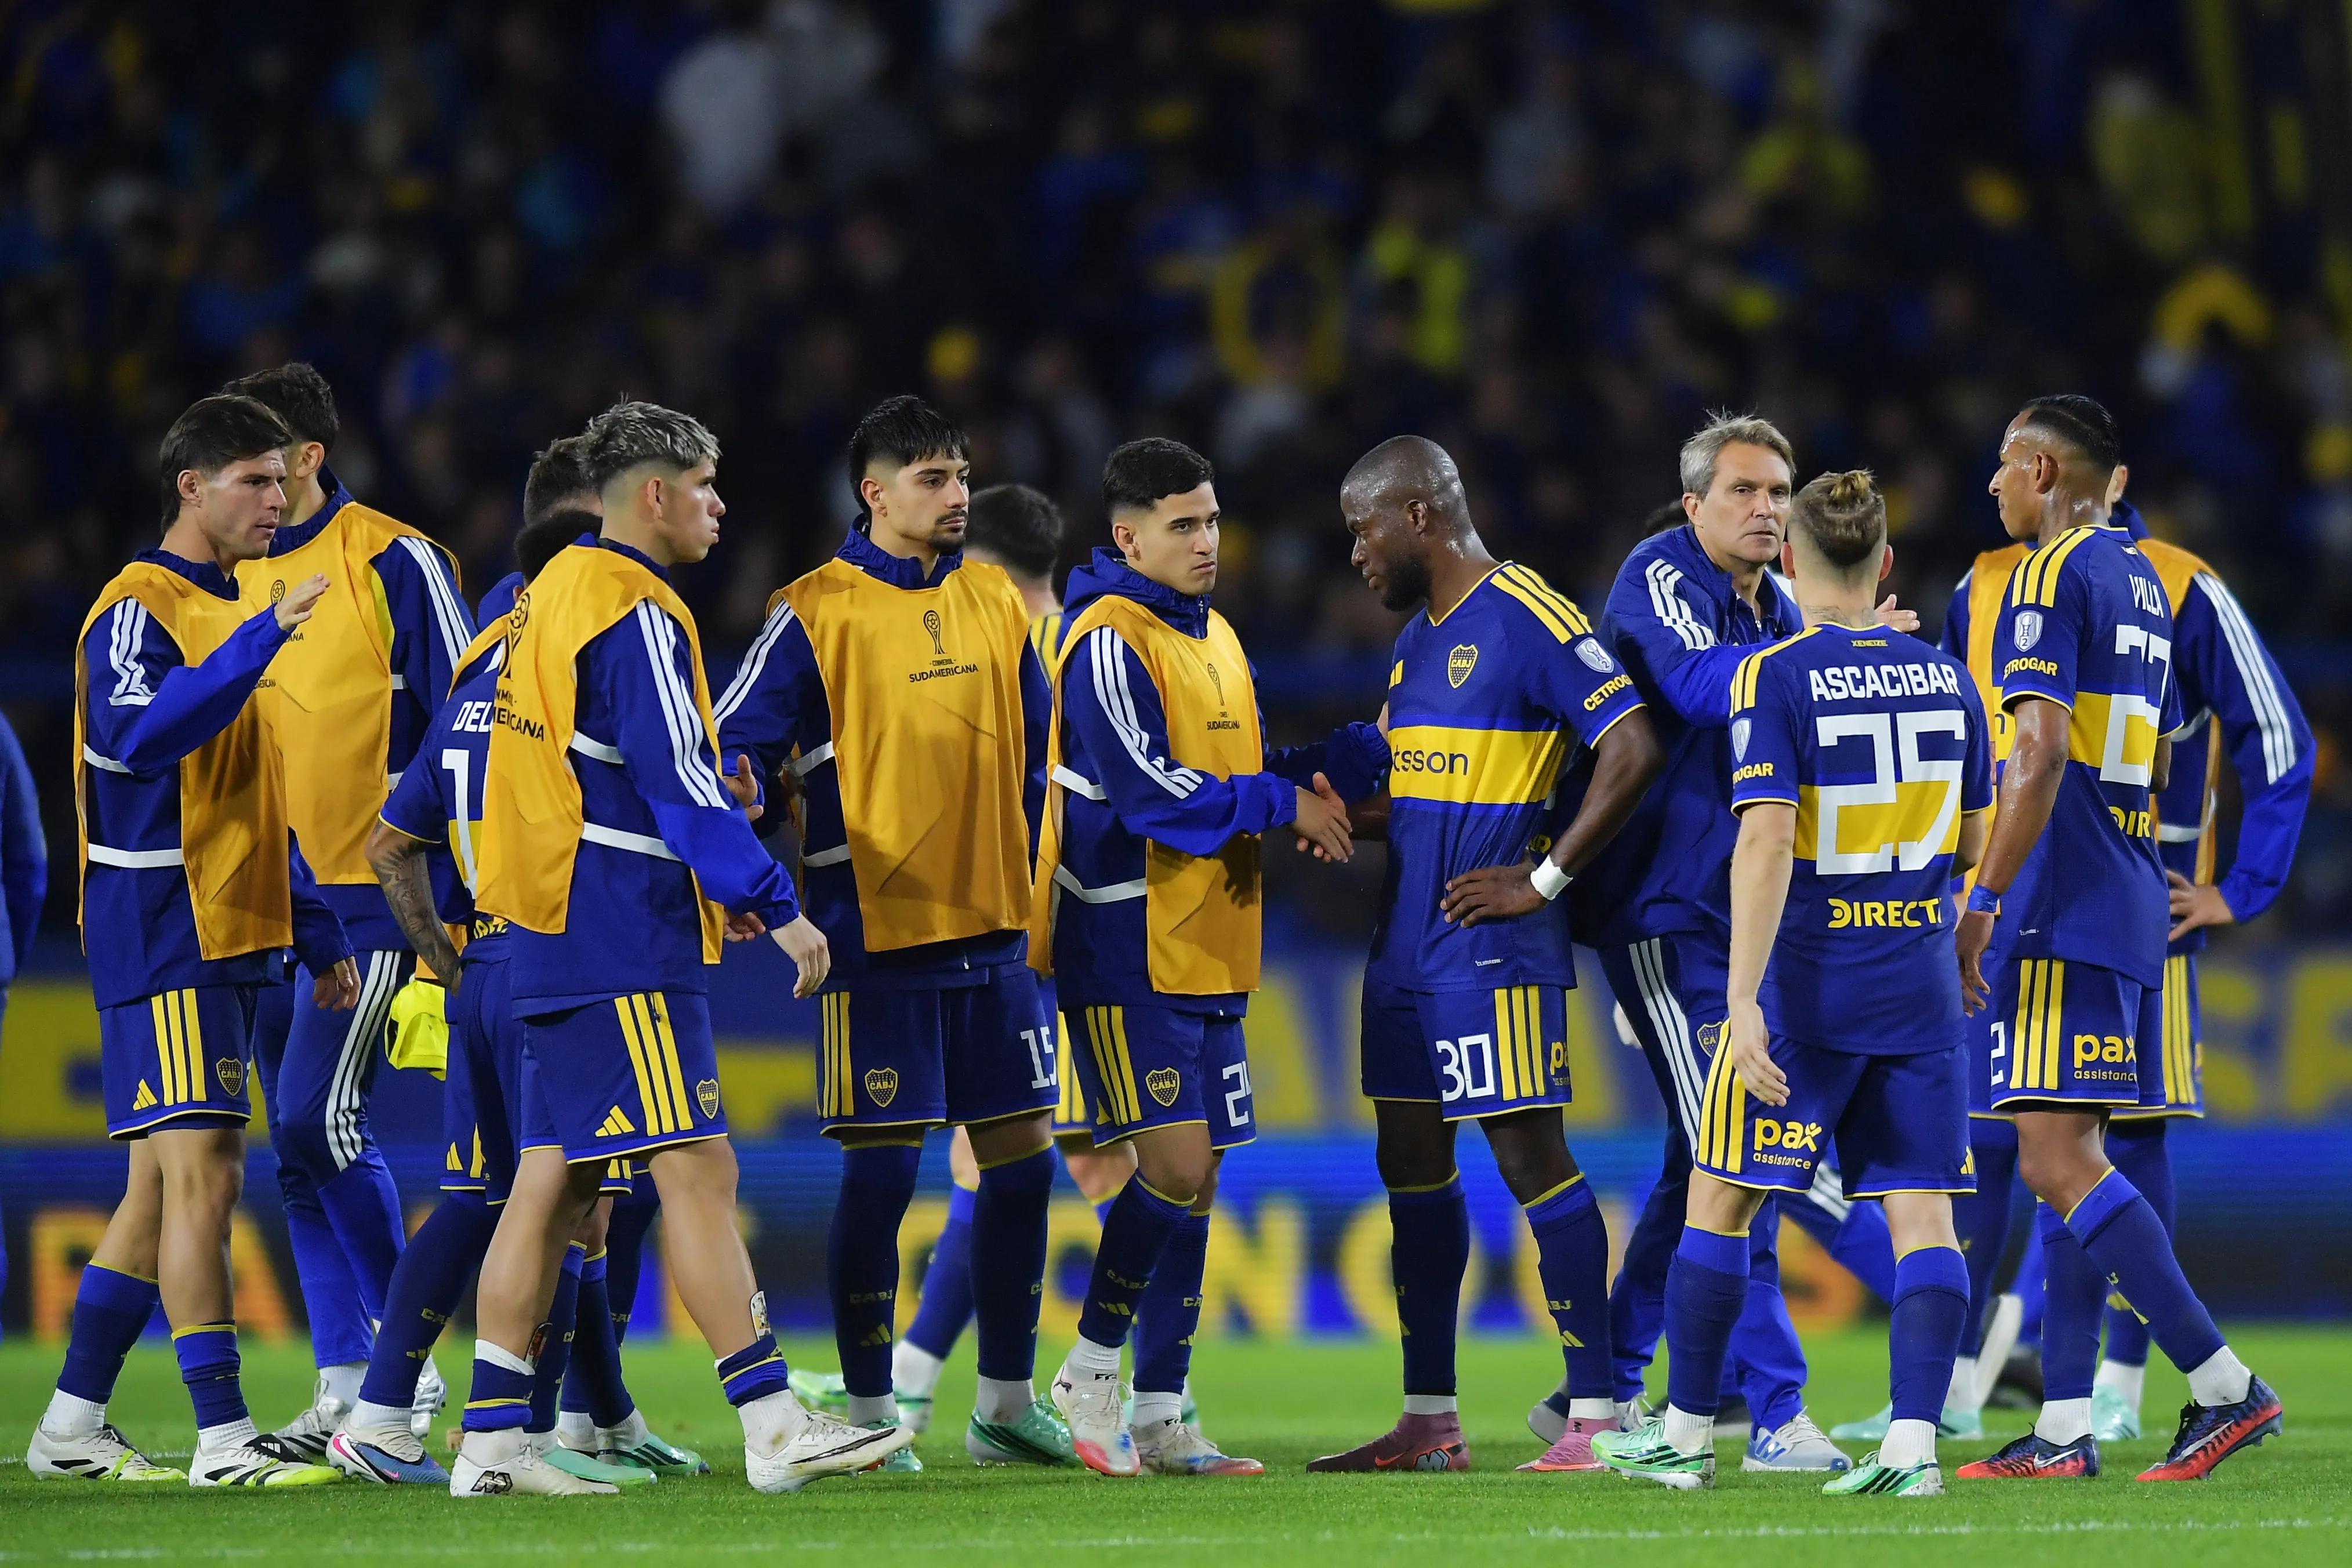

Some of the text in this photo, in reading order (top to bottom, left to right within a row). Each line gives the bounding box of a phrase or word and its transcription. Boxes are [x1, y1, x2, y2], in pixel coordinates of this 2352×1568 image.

[2128, 574, 2164, 619] VILLA
[2021, 638, 2028, 647] 2
[909, 663, 979, 683] SUDAMERICANA
[1451, 659, 1473, 667] CABJ
[1601, 660, 1610, 669] 2
[1809, 662, 1961, 702] ASCACIBAR
[452, 701, 494, 732] DEL
[1393, 745, 1468, 776] tsson
[1816, 710, 1965, 876] 25
[1827, 898, 1943, 928] DIRECT
[1703, 1036, 1716, 1045] CA
[1020, 1026, 1057, 1089] 15
[1435, 1033, 1496, 1102] 30
[221, 1070, 241, 1079] CABJ
[869, 1080, 894, 1090] CABJ
[1152, 1080, 1177, 1091] CABJ
[1754, 1117, 1823, 1152] pax
[1752, 1152, 1812, 1170] assistance
